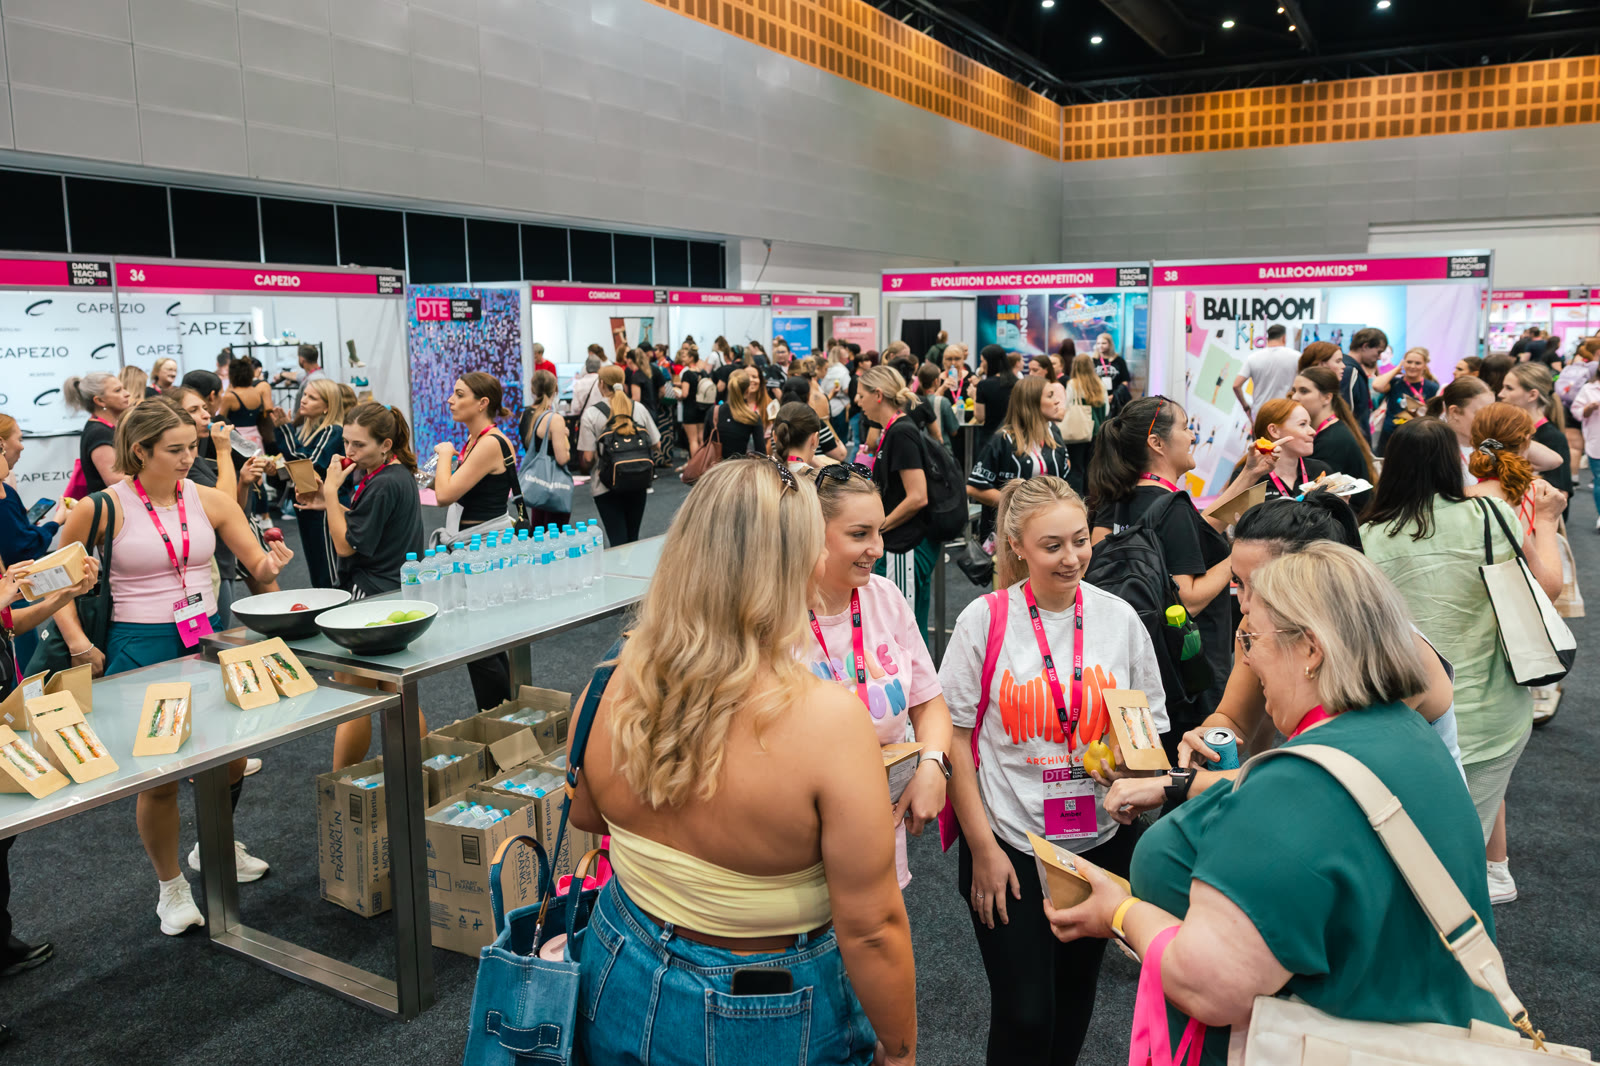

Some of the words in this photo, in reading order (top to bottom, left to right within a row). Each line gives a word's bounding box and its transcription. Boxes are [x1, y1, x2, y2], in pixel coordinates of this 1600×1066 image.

[72, 263, 99, 271] DANCE
[72, 270, 108, 278] TEACHER
[130, 269, 146, 281] 36
[254, 273, 300, 287] CAPEZIO
[931, 277, 984, 287] EVOLUTION
[986, 275, 1021, 285] DANCE
[1023, 273, 1094, 285] COMPETITION
[1164, 271, 1178, 282] 38
[891, 278, 903, 288] 37
[537, 290, 544, 298] 15
[419, 301, 448, 317] DTE
[1204, 298, 1315, 320] BALLROOM
[0, 346, 69, 358] APEZIO
[173, 599, 188, 610] DTE
[852, 600, 860, 613] DTE
[1033, 618, 1042, 631] DTE
[1048, 668, 1057, 682] DTE
[1026, 755, 1071, 765] ARCHIVE
[1045, 769, 1069, 781] DTE
[328, 821, 337, 865] MOUNT
[334, 810, 345, 882] FRANKLIN
[381, 836, 390, 869] MOUNT
[517, 843, 527, 901] FRANKLIN
[524, 851, 532, 885] MOUNT
[454, 880, 485, 893] FRANKLIN
